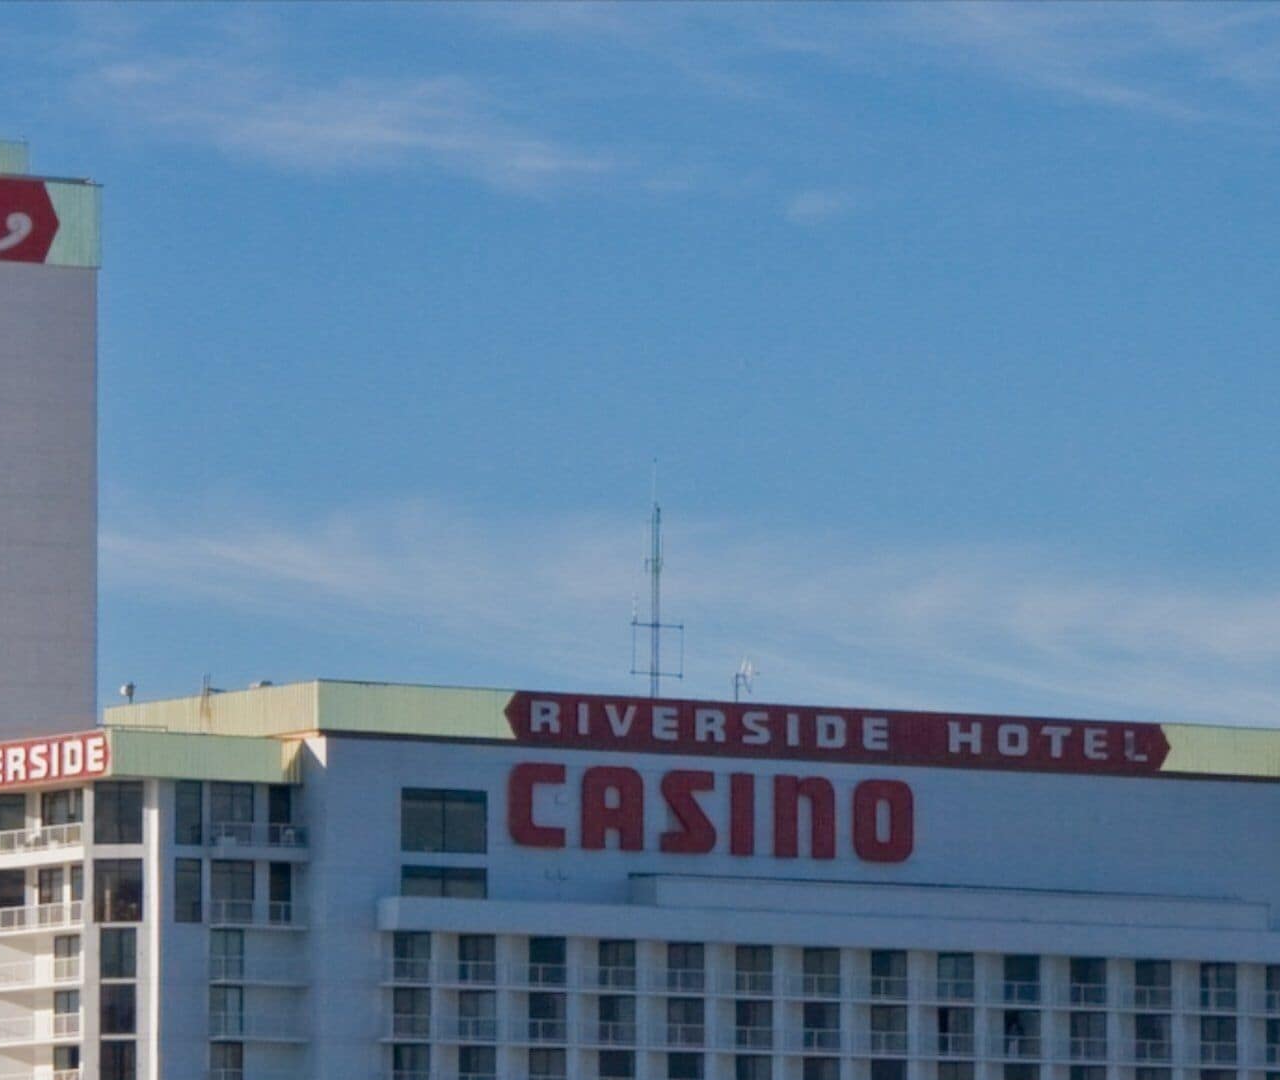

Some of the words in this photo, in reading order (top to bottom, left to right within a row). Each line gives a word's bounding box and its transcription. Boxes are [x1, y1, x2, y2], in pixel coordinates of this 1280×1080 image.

[530, 700, 888, 750] RIVERSIDE
[947, 720, 1148, 762] HOTEL
[507, 763, 914, 862] CASINO
